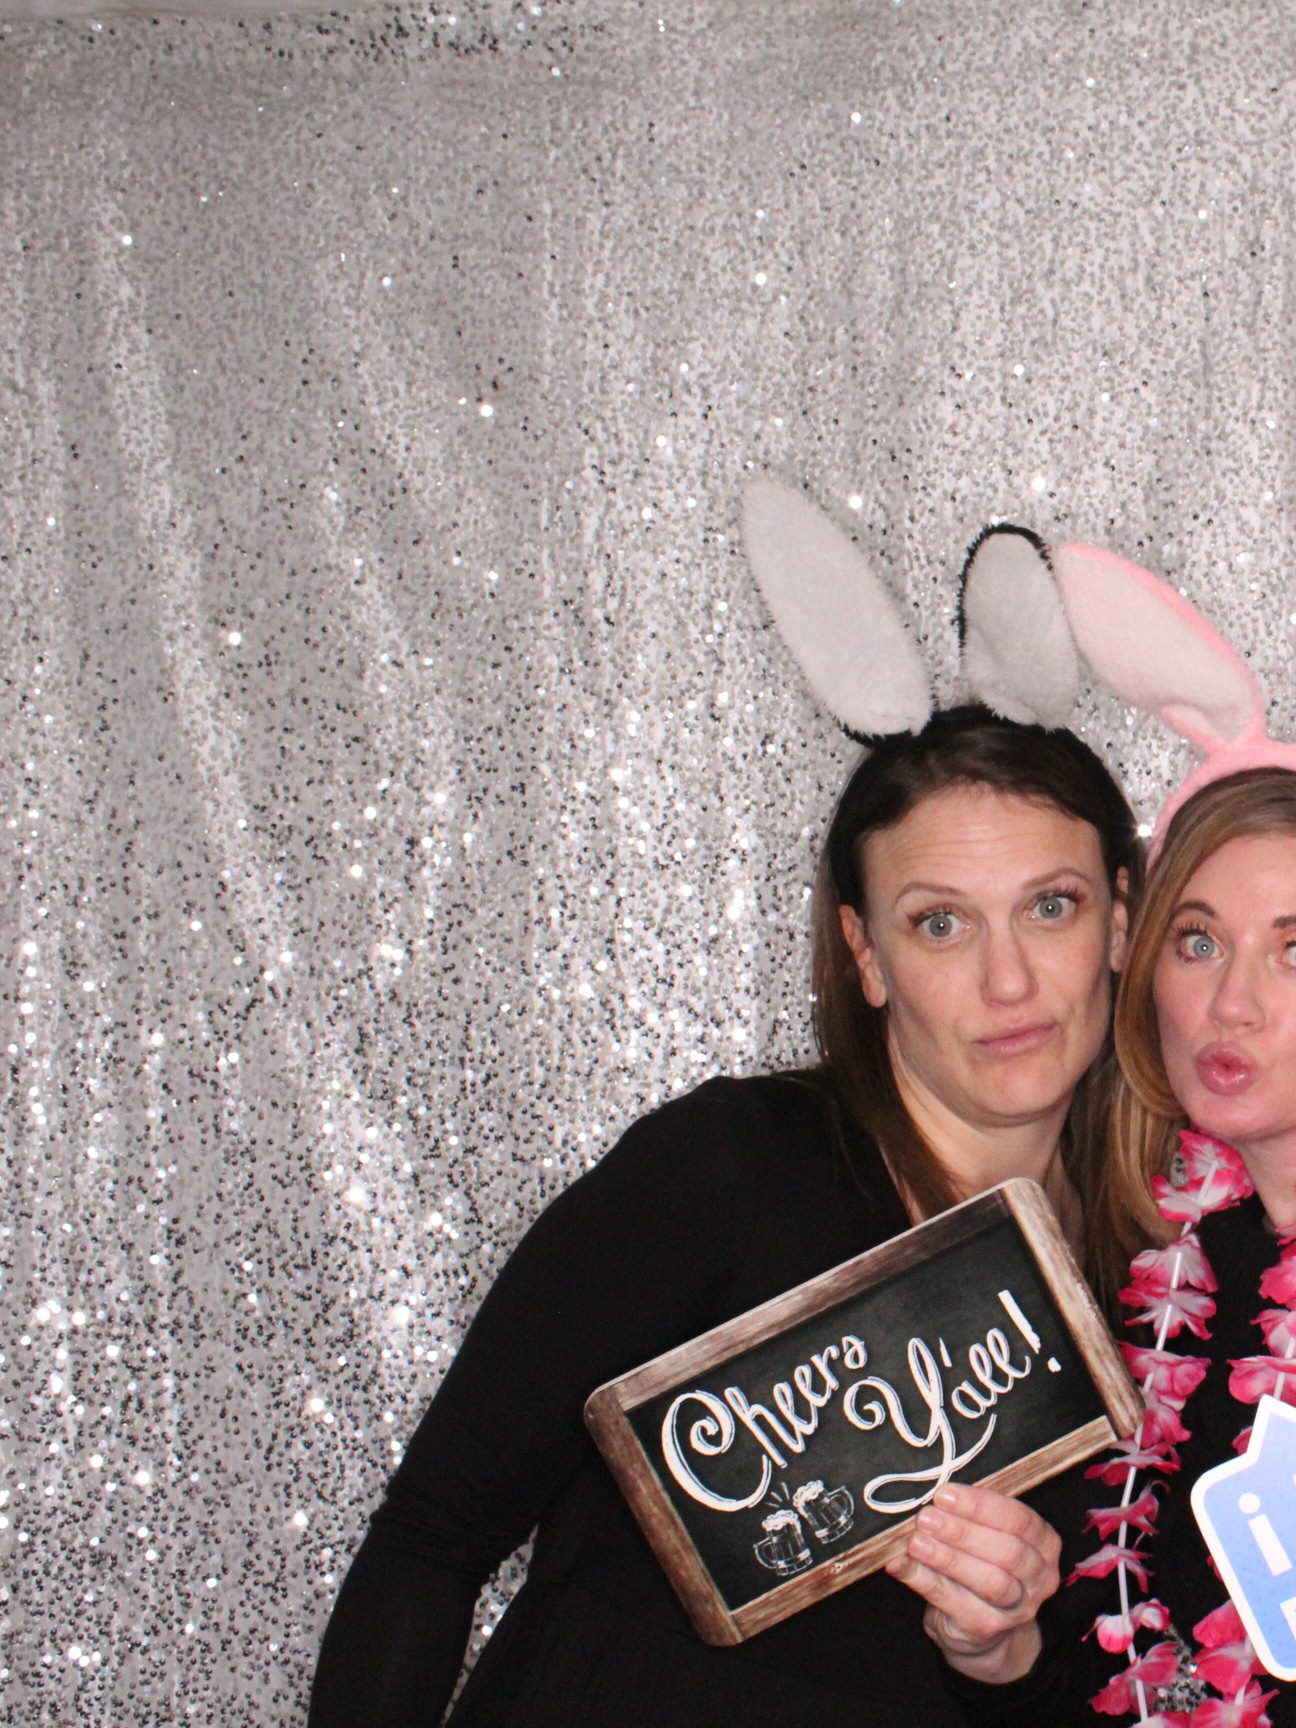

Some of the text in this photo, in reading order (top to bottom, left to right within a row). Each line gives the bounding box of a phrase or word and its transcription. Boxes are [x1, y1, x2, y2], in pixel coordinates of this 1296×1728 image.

[661, 1289, 1061, 1513] Cheers Y'all!
[1238, 1492, 1293, 1576] i
